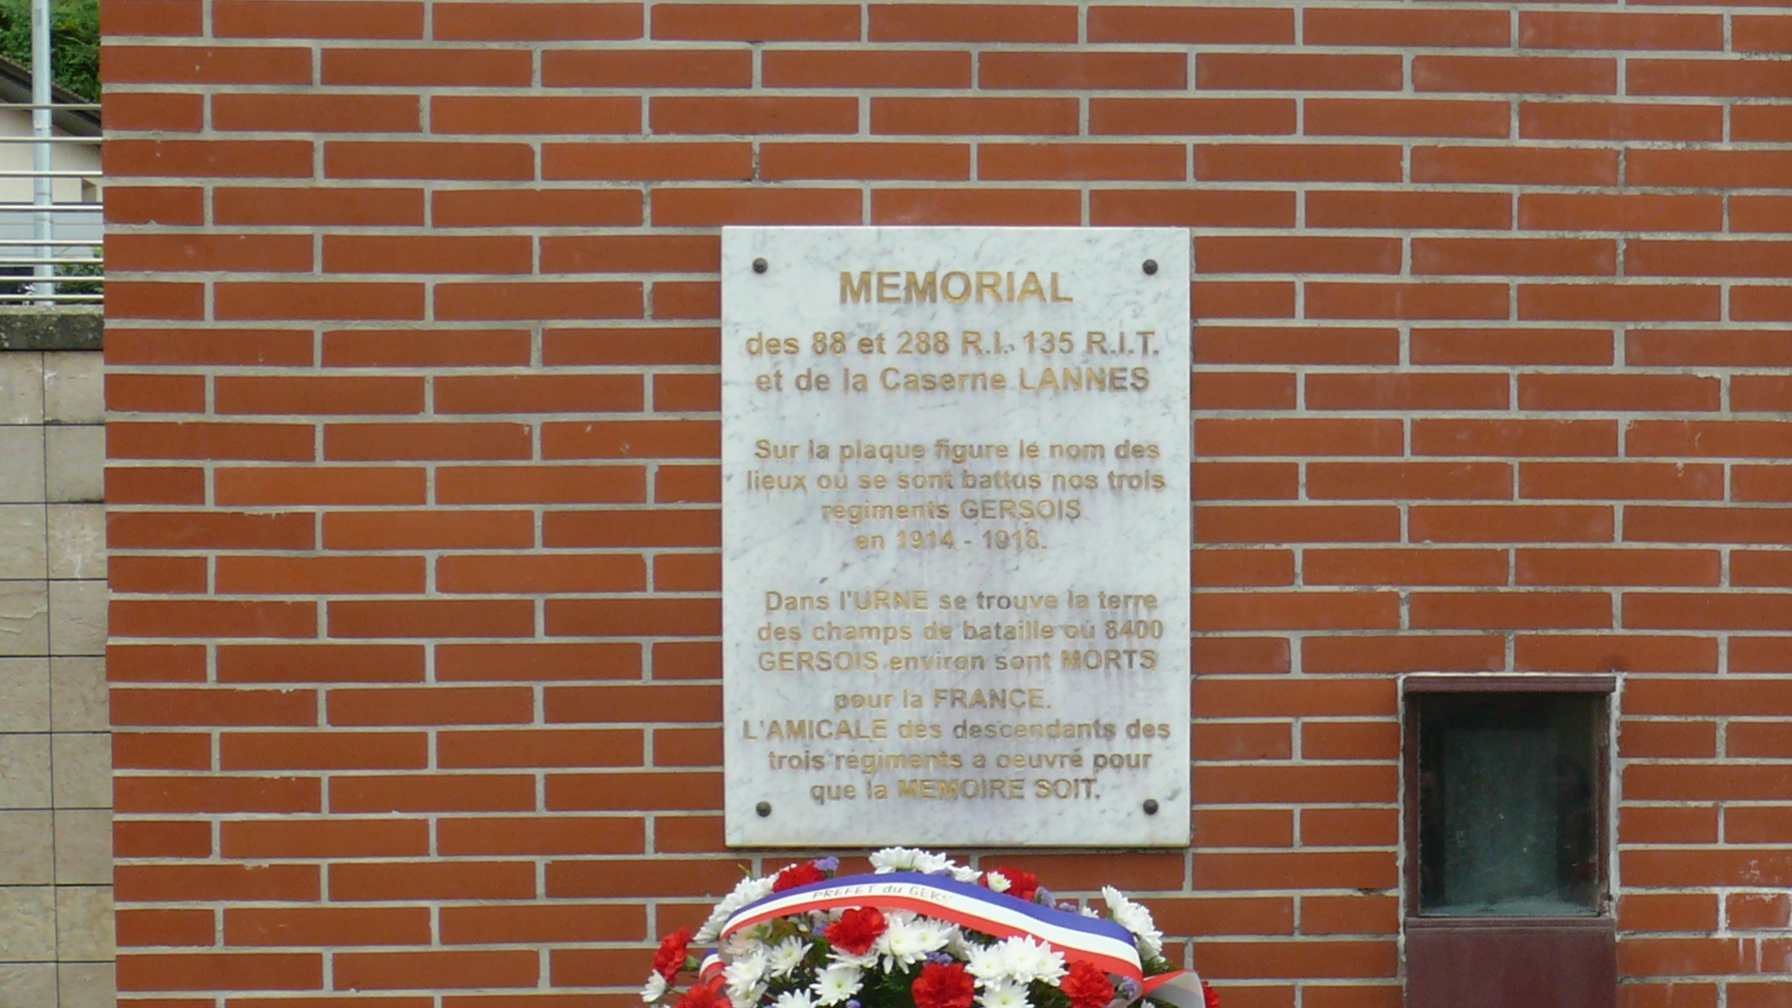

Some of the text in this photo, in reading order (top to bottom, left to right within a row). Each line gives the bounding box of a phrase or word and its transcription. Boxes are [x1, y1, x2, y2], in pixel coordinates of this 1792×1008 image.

[839, 271, 1073, 304] MEMORIAL
[745, 330, 1160, 356] des 88 et 288 R.I. 135 R.I.T.
[755, 366, 1150, 392] et de la Caserne LANNES
[754, 439, 1161, 465] Sur la plaque figure le nom des
[746, 467, 1166, 491] lieux où se sont battus nos trois
[960, 499, 1082, 520] GERSOIS
[854, 533, 885, 551] en
[896, 530, 954, 550] 1914
[981, 529, 1048, 550] 1918.
[765, 589, 1159, 611] Dans l'URNE se trouve la terre
[757, 621, 802, 642] des
[811, 621, 913, 646] champs
[922, 621, 953, 641] de
[963, 620, 1055, 641] bataille
[1104, 619, 1164, 640] 8400
[758, 649, 1157, 672] GERSOIS environ sont MORTS
[834, 688, 1052, 713] pour la FRANCE.
[742, 718, 1171, 740] L'AMICALE des descendants des
[768, 750, 826, 771] trois
[834, 749, 963, 775] régiments
[972, 753, 987, 769] a
[1093, 753, 1153, 774] pour
[809, 778, 1102, 806] que la MEMOIRE SOIT.
